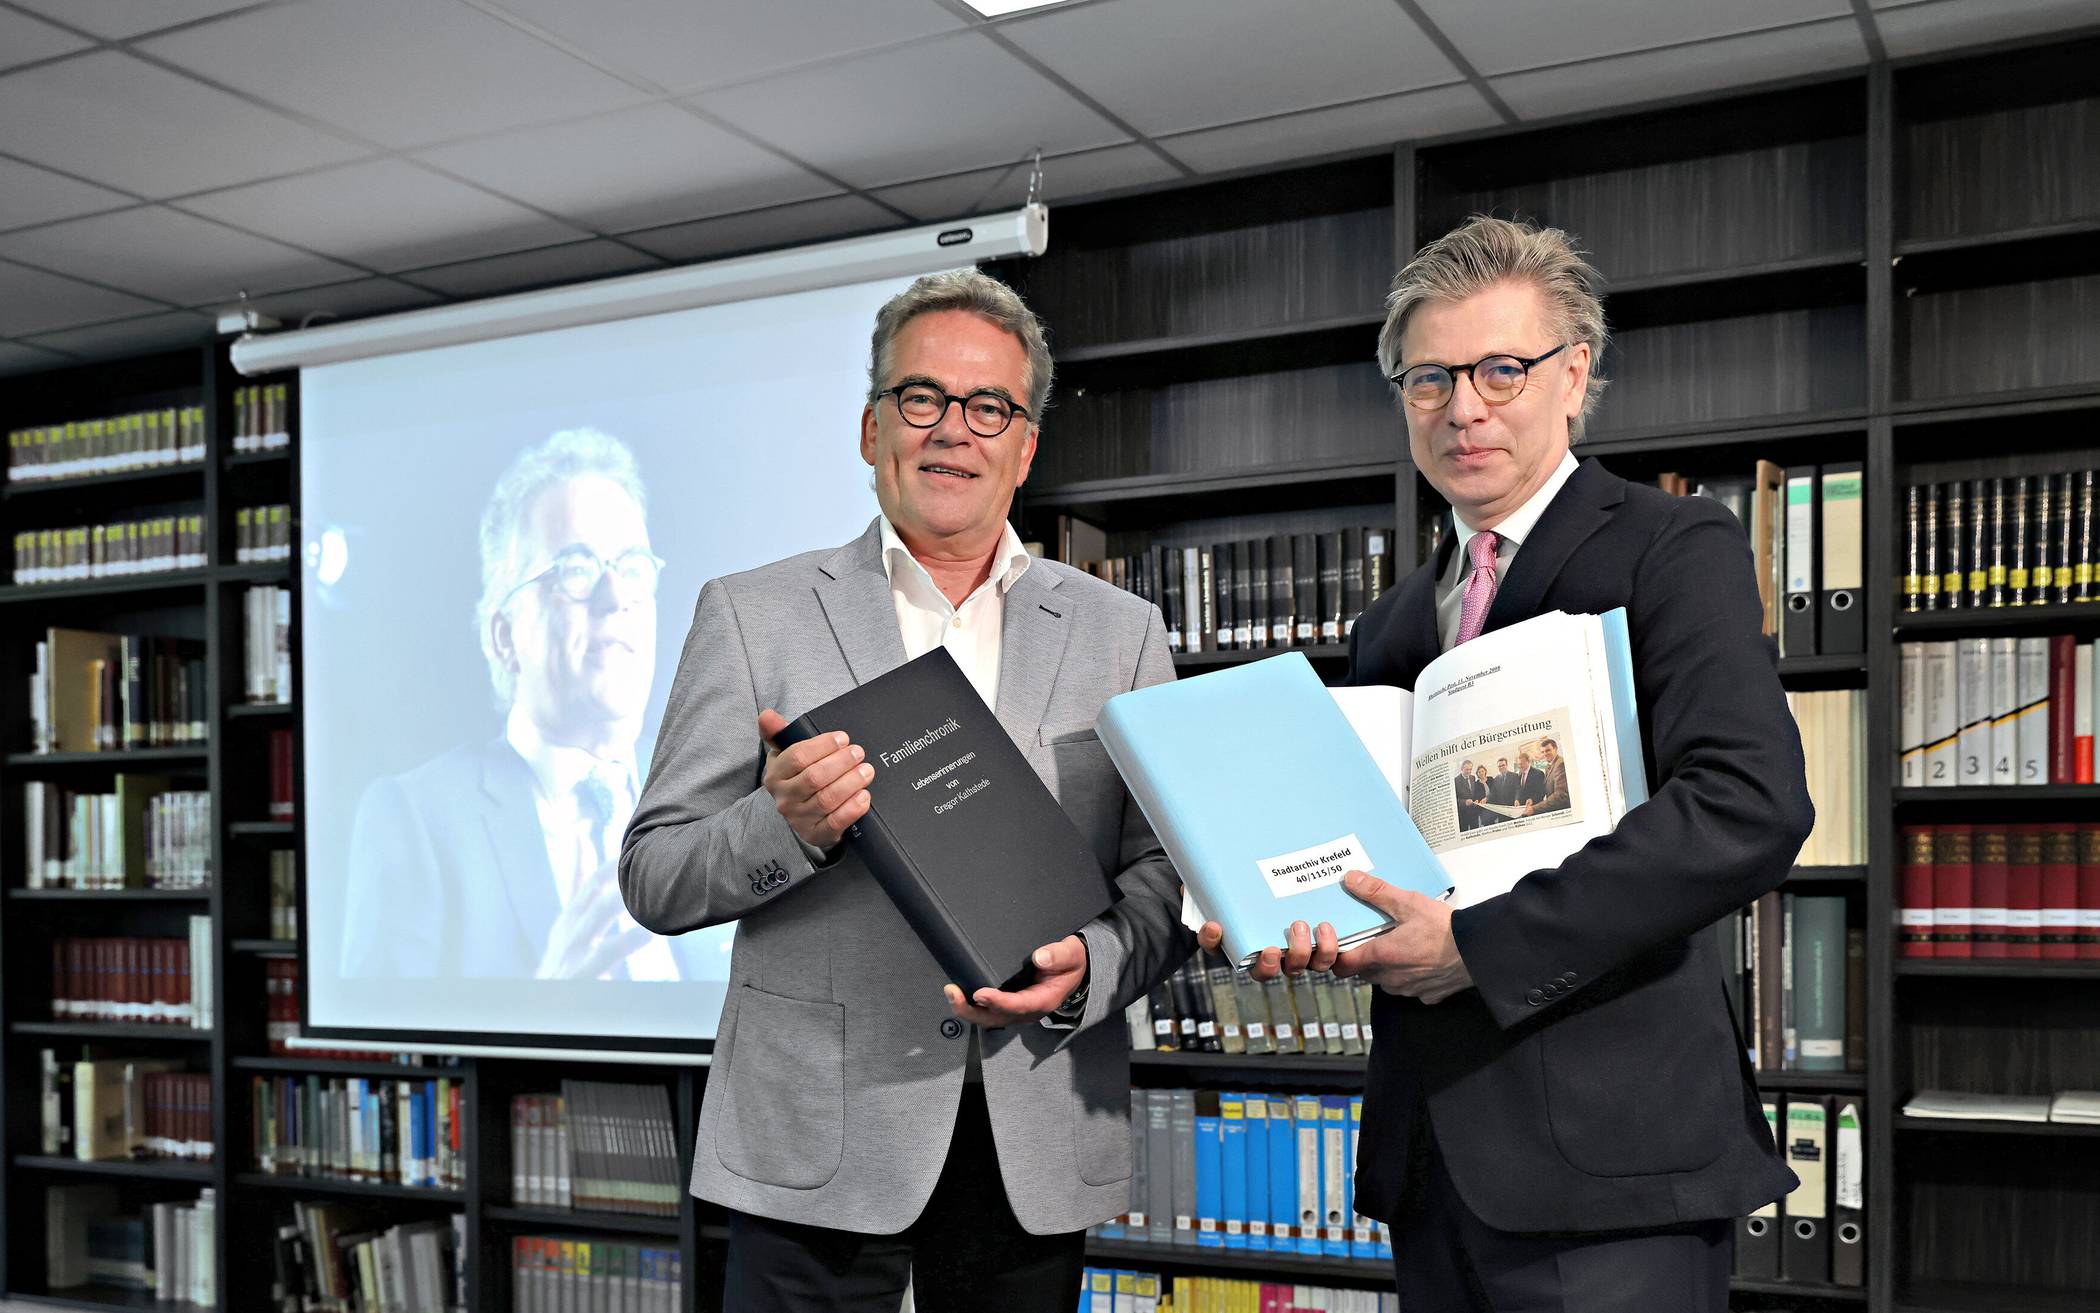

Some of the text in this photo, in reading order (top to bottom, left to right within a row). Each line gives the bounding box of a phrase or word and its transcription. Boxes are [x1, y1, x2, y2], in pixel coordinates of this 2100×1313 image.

[879, 717, 961, 768] Familienchronik
[1415, 719, 1553, 769] Wellen hilft der Bürgerstiftung
[911, 750, 976, 791] Lebenserinnerungen
[1906, 761, 1913, 778] 1
[1933, 760, 1946, 779] 2
[1966, 755, 1980, 775] 3
[1995, 756, 2009, 775] 4
[2025, 760, 2039, 778] 5
[945, 778, 960, 790] von
[934, 777, 991, 814] Gregor Kathstede
[1271, 847, 1351, 877] Stadtarchiv Krefeld
[1296, 864, 1342, 883] 40/115/50
